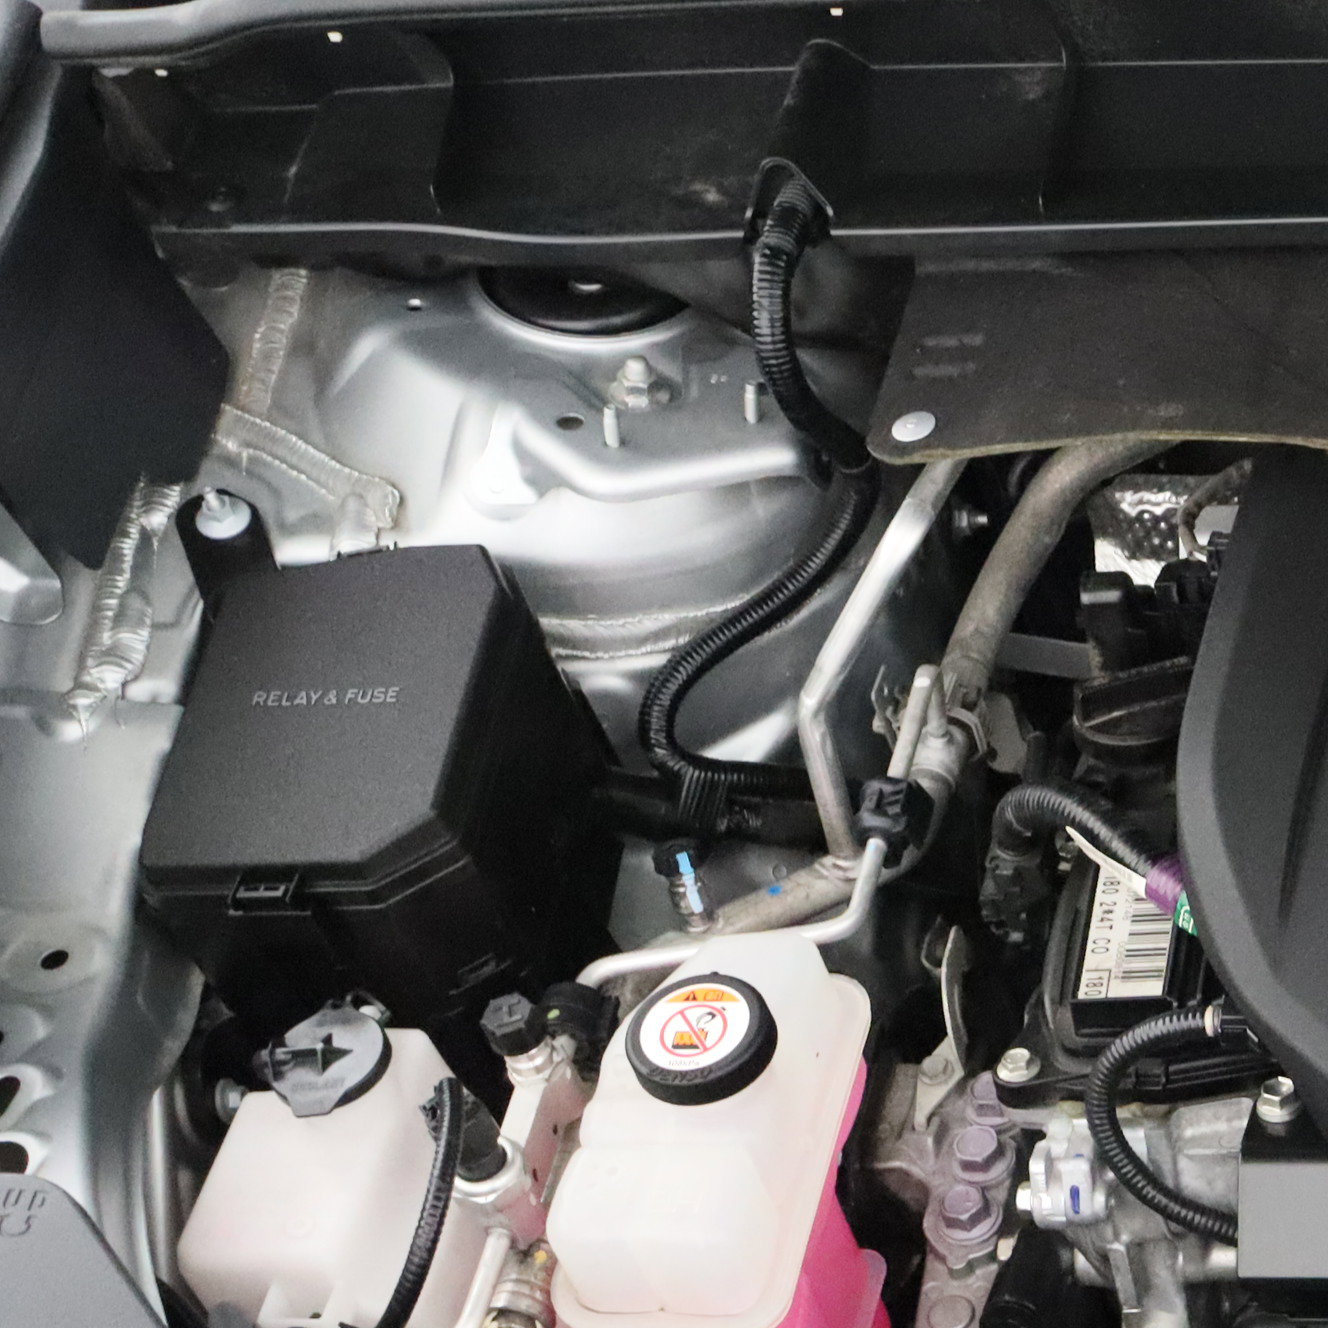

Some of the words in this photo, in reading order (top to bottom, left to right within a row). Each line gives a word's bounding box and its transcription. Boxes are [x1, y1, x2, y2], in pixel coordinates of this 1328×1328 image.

[252, 690, 322, 706] RELAY
[324, 689, 337, 705] &
[345, 687, 400, 704] FUSE
[1084, 976, 1104, 996] 180
